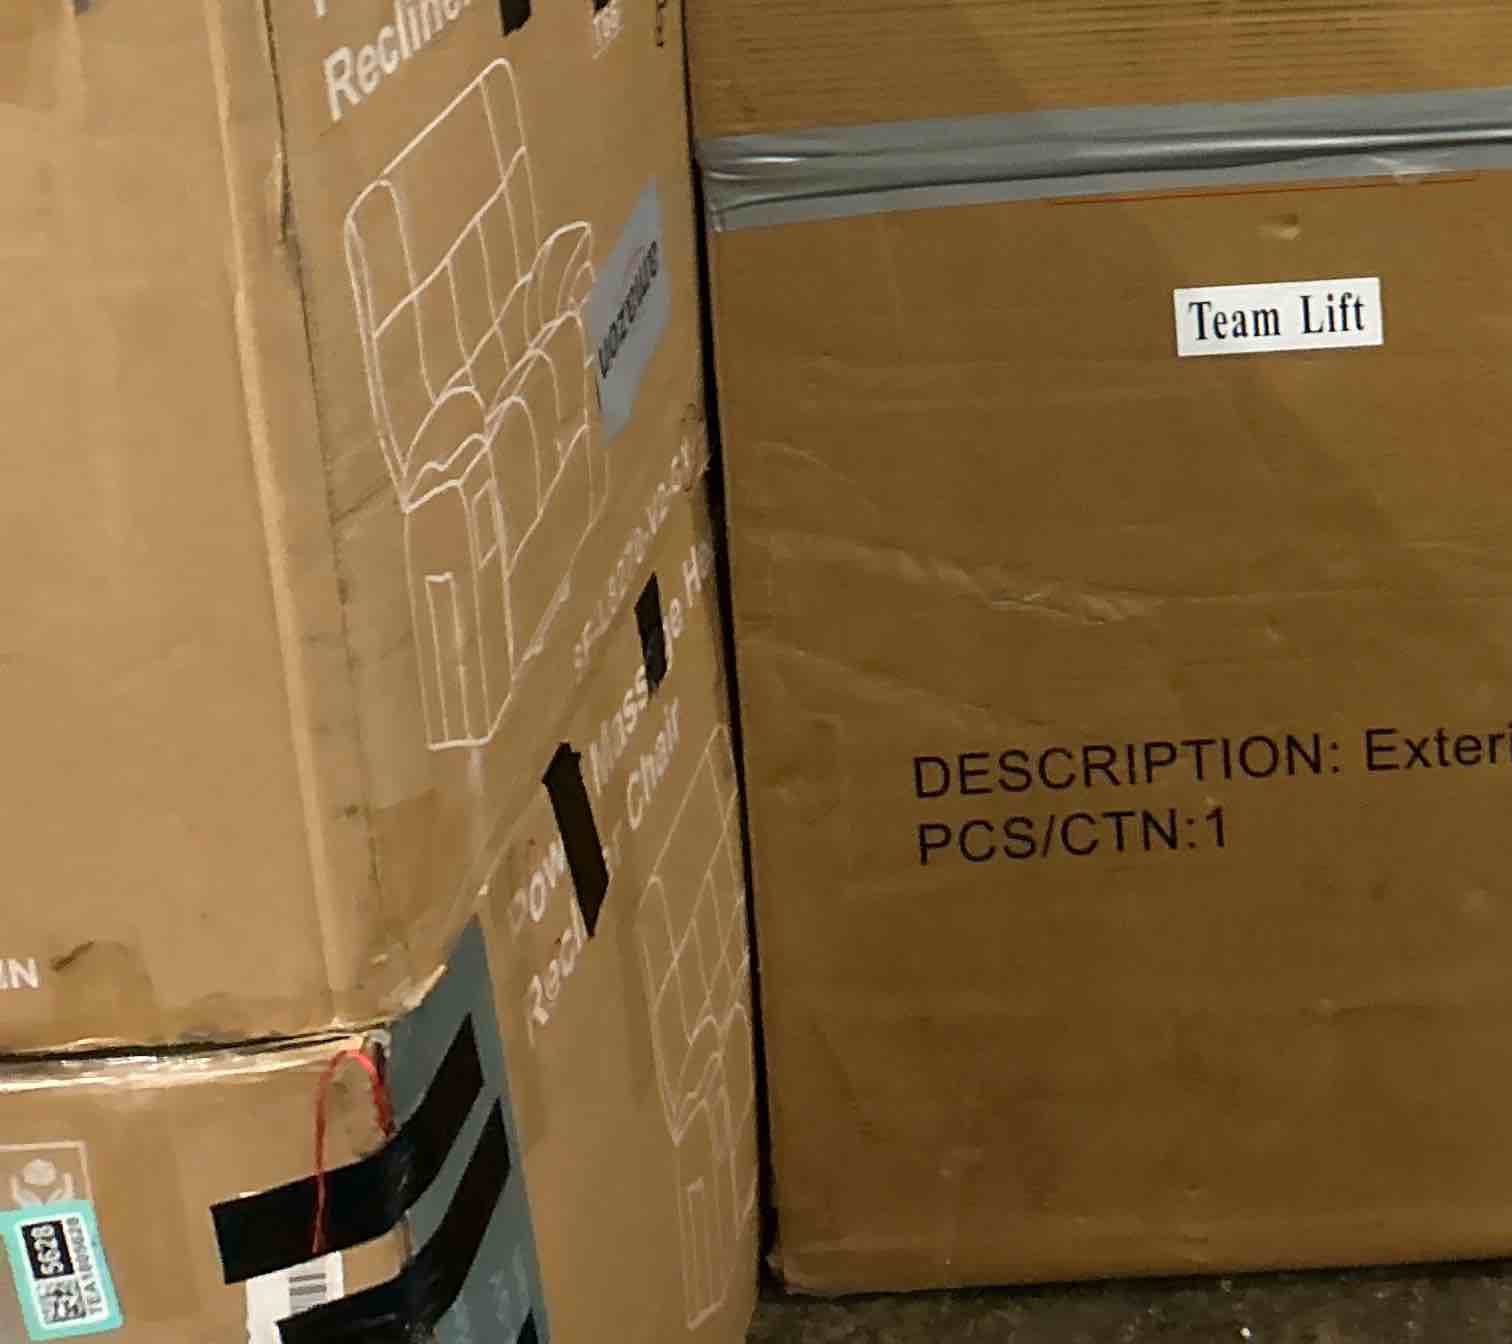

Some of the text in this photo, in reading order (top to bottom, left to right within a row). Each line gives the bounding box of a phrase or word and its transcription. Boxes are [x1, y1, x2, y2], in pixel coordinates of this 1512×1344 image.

[1188, 291, 1366, 341] Team Lift
[589, 596, 683, 797] Masse
[627, 696, 681, 831] Chair
[912, 732, 1341, 799] DESCRIPTION:
[918, 807, 1226, 865] PCS/CTN:1
